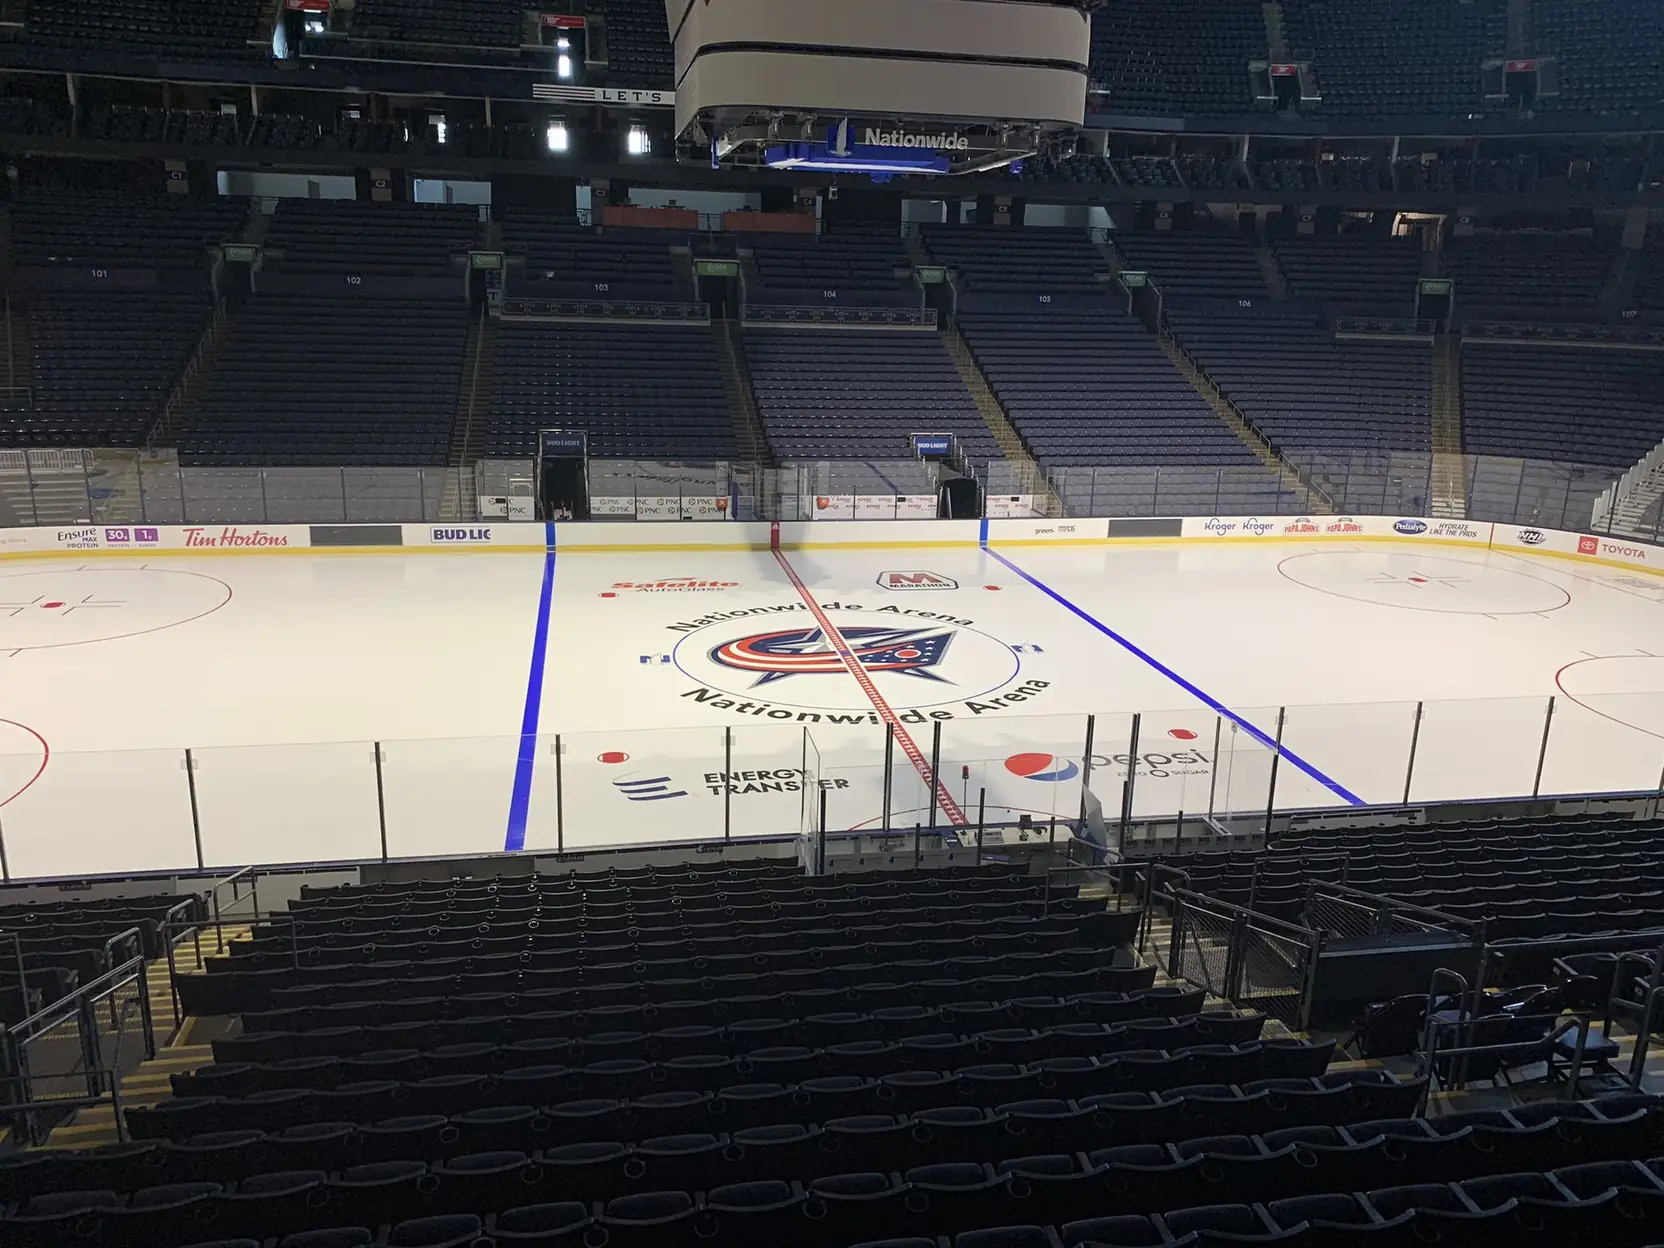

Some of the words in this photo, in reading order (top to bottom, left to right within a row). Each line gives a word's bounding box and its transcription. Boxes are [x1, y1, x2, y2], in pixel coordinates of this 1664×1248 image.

[602, 90, 662, 102] LET'S
[865, 128, 968, 149] Nationwide
[171, 171, 182, 179] C1
[375, 179, 387, 187] C2
[91, 269, 108, 278] 101
[347, 276, 362, 285] 102
[594, 283, 609, 292] 103
[823, 290, 837, 299] 104
[1038, 295, 1051, 304] 105
[1238, 299, 1252, 308] 106
[1204, 517, 1236, 536] Kroger
[1242, 517, 1274, 536] Kroger
[1396, 522, 1428, 532] Pedialyte
[1438, 523, 1470, 531] HYDRATE
[57, 528, 96, 541] Ensure
[183, 527, 216, 547] Tim
[219, 527, 288, 547] Hortons
[433, 529, 467, 540] BUD
[1459, 530, 1478, 538] PROS
[1518, 529, 1546, 543] NHL
[1602, 543, 1646, 559] TOYOTA
[610, 580, 741, 589] Safelite
[666, 602, 864, 633] Nationwide
[870, 605, 974, 627] Arena
[680, 687, 956, 726] Nationwide
[963, 678, 1051, 716] Arena
[1080, 748, 1210, 771] pepsi
[704, 768, 808, 783] ENERGY
[706, 778, 850, 796] TRANSER
